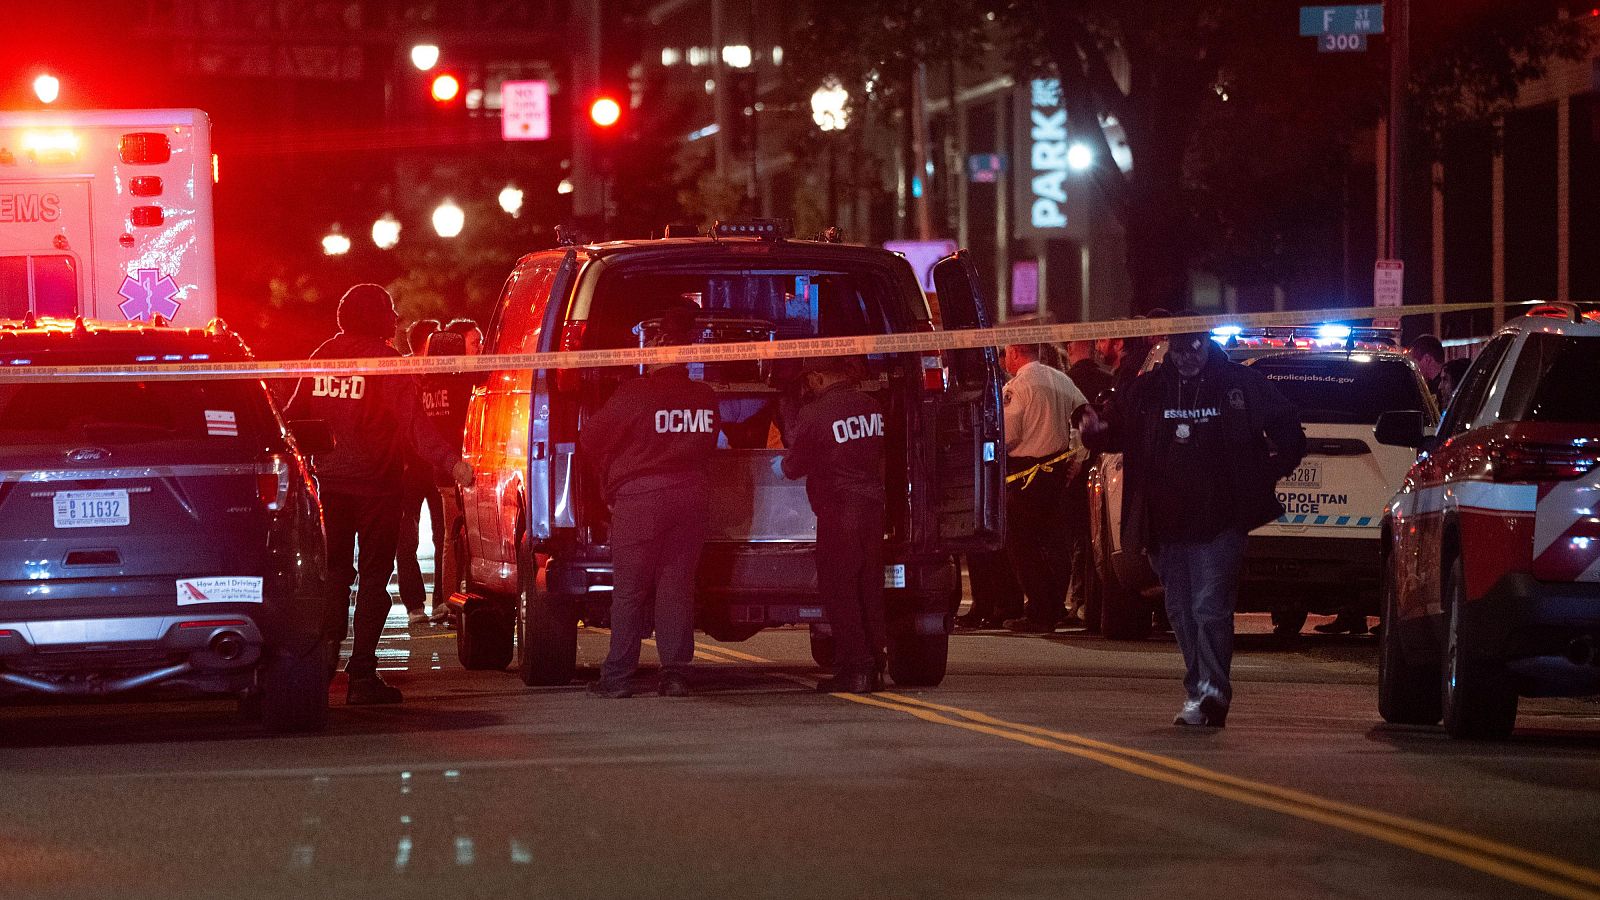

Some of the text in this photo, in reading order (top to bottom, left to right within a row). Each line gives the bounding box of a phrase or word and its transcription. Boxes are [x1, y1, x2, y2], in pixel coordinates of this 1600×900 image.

[1323, 10, 1335, 31] F
[1326, 35, 1359, 50] 300
[0, 193, 60, 222] EMS
[1266, 374, 1354, 383] dcpolicejobs.dc.gov
[312, 375, 365, 400] DCFD
[1164, 407, 1221, 419] ESSENTIAL
[655, 409, 714, 433] OCME
[832, 413, 885, 444] OCME
[75, 451, 100, 460] Ford
[1286, 469, 1317, 481] 5287
[1276, 493, 1347, 504] OPOLITAN
[81, 500, 120, 518] 11632
[232, 580, 261, 588] Driving?
